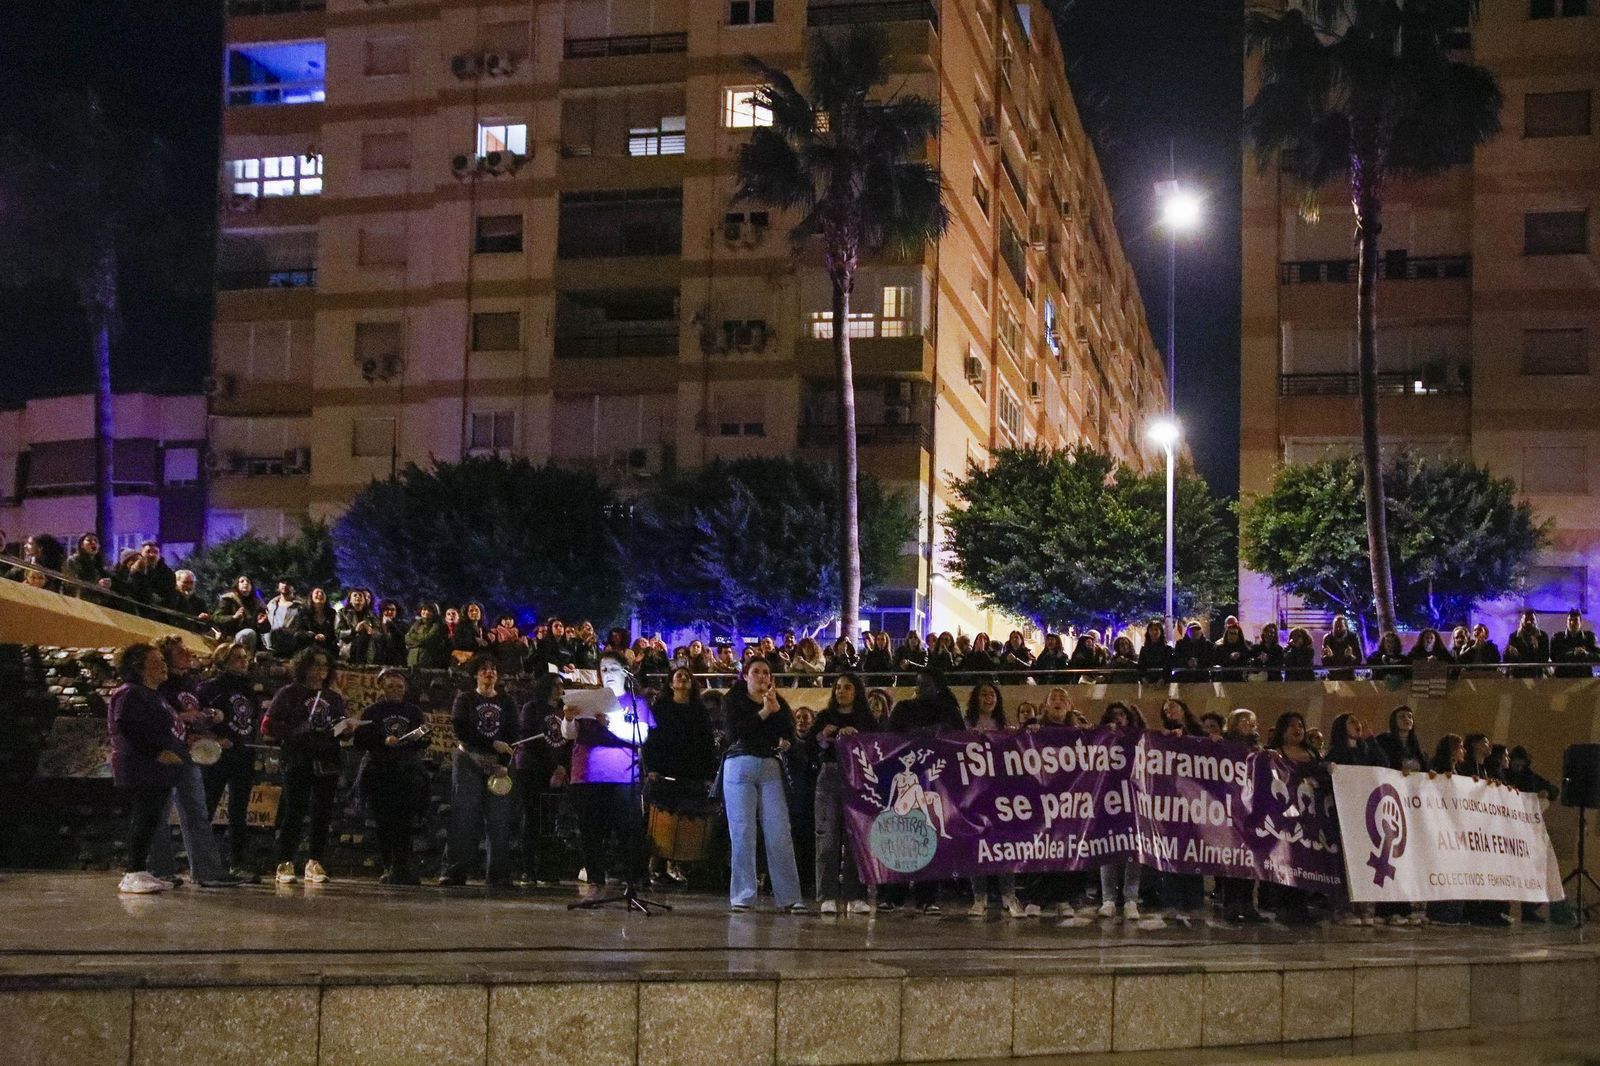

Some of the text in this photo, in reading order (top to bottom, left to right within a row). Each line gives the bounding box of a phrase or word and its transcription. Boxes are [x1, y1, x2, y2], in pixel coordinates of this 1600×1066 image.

[957, 742, 996, 785] ¡Si
[1003, 738, 1128, 776] nosotras
[994, 780, 1233, 828] se para el mundo!
[1404, 796, 1422, 808] NO
[1452, 798, 1488, 814] VIOLENCIA
[978, 833, 1064, 863] Asamblea
[1067, 826, 1152, 859] Feminista
[1183, 838, 1255, 867] Almería
[1438, 827, 1490, 854] ALMERÍA
[1428, 872, 1485, 887] COLECTIVOS
